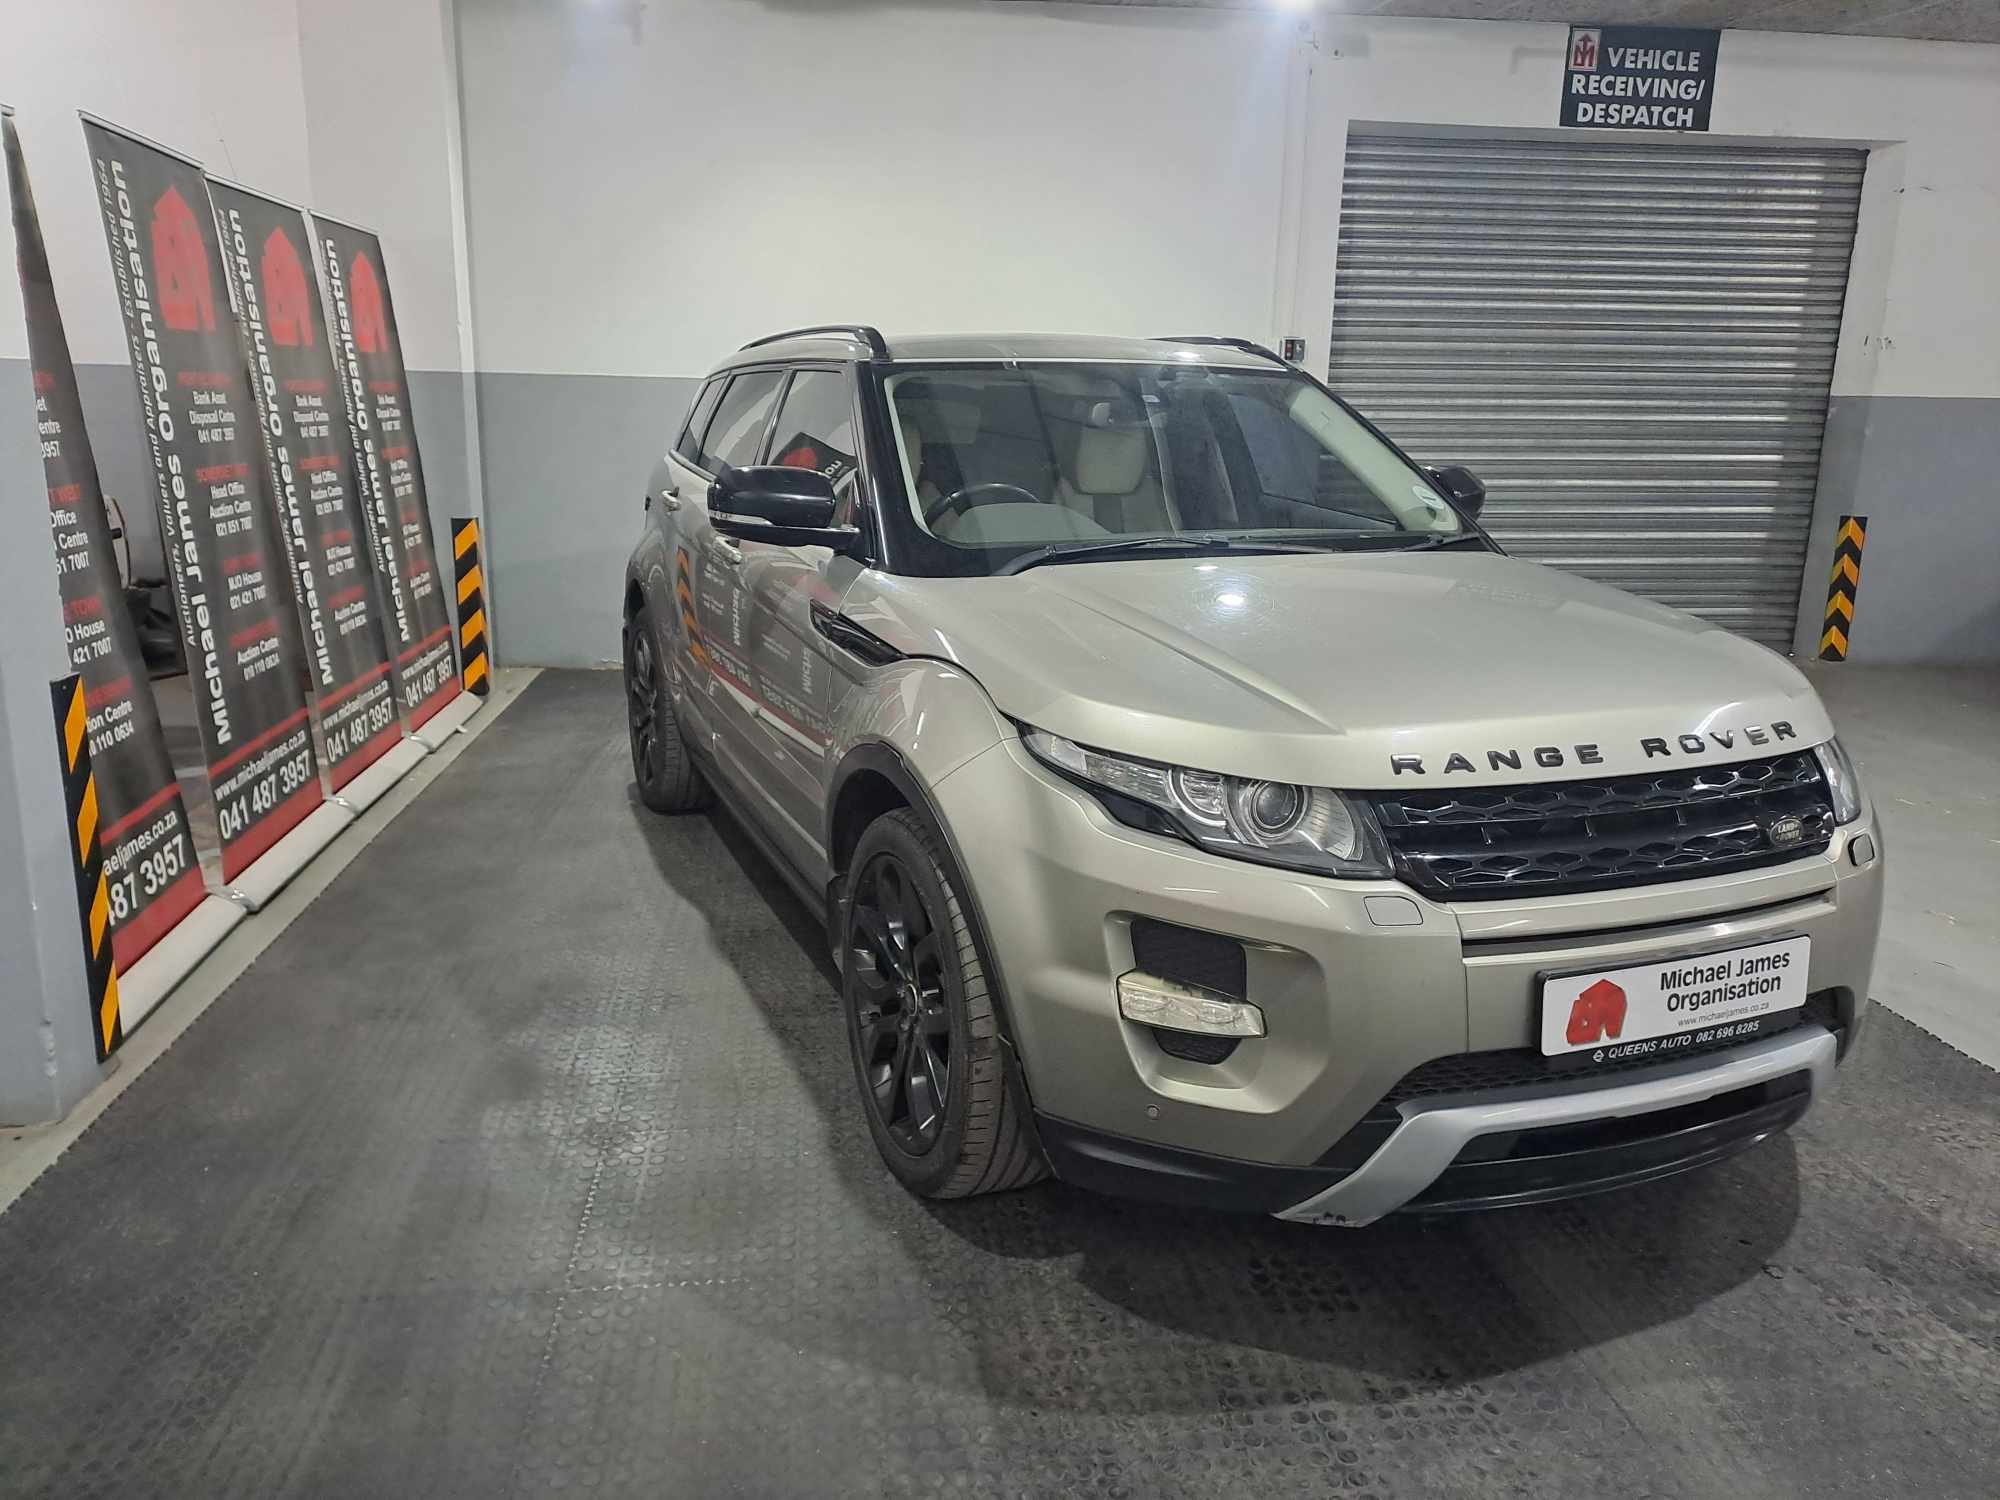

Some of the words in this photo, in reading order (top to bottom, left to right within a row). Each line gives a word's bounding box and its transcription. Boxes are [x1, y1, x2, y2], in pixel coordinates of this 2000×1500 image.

[1571, 74, 1705, 100] RECEIVING/
[1608, 47, 1700, 72] VEHICLE
[1577, 102, 1694, 127] DESPATCH
[111, 160, 174, 442] Organisation
[229, 209, 282, 437] Organisation
[326, 239, 369, 431] Organisation
[131, 335, 156, 430] Appraisers
[149, 432, 163, 468] and
[157, 472, 176, 536] Valuers
[277, 446, 307, 552] James
[364, 439, 388, 528] James
[168, 454, 203, 584] James
[382, 536, 410, 641] Michael
[73, 620, 105, 640] House
[73, 645, 91, 664] 421
[91, 636, 112, 658] 7007
[298, 561, 334, 685] Michael
[196, 592, 232, 745] Michael
[405, 681, 421, 708] 041
[422, 668, 436, 691] 487
[436, 654, 453, 682] 3957
[96, 732, 113, 752] 110
[105, 699, 133, 724] Centre
[326, 727, 350, 763] 041
[350, 714, 368, 744] 487
[368, 697, 392, 732] 3957
[1390, 744, 1604, 775] RANGE
[1641, 720, 1797, 758] ROVER
[220, 795, 250, 842] 041
[252, 774, 277, 816] 487
[280, 749, 311, 794] 3957
[109, 874, 138, 925] 87
[140, 834, 187, 896] 3957
[1660, 960, 1731, 990] Michael
[1736, 952, 1790, 977] James
[1667, 975, 1781, 1011] Organisation
[1608, 1040, 1657, 1059] QUEENS
[1660, 1035, 1691, 1049] AUTO
[1696, 1030, 1715, 1043] 082
[1716, 1026, 1735, 1039] 696
[1736, 1020, 1760, 1035] 8285
